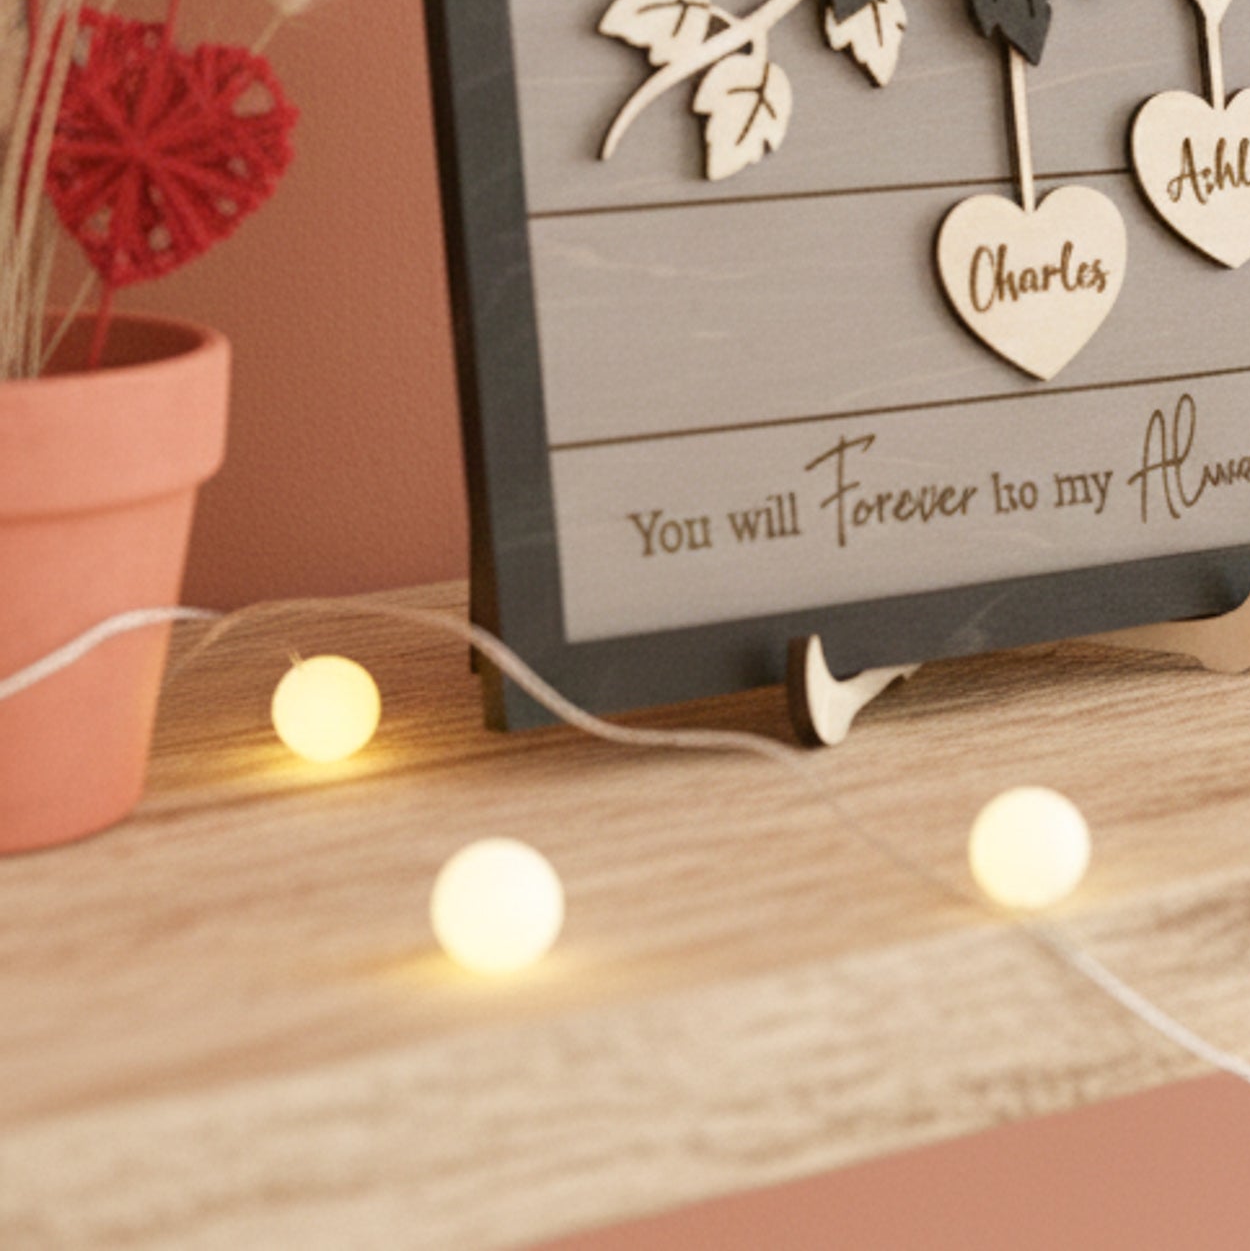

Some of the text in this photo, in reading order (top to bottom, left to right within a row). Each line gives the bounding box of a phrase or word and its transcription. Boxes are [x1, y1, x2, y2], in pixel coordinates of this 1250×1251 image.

[968, 240, 1110, 313] Charles
[626, 508, 714, 557] You
[726, 491, 803, 543] will
[804, 433, 979, 548] Forever
[1053, 470, 1114, 515] my
